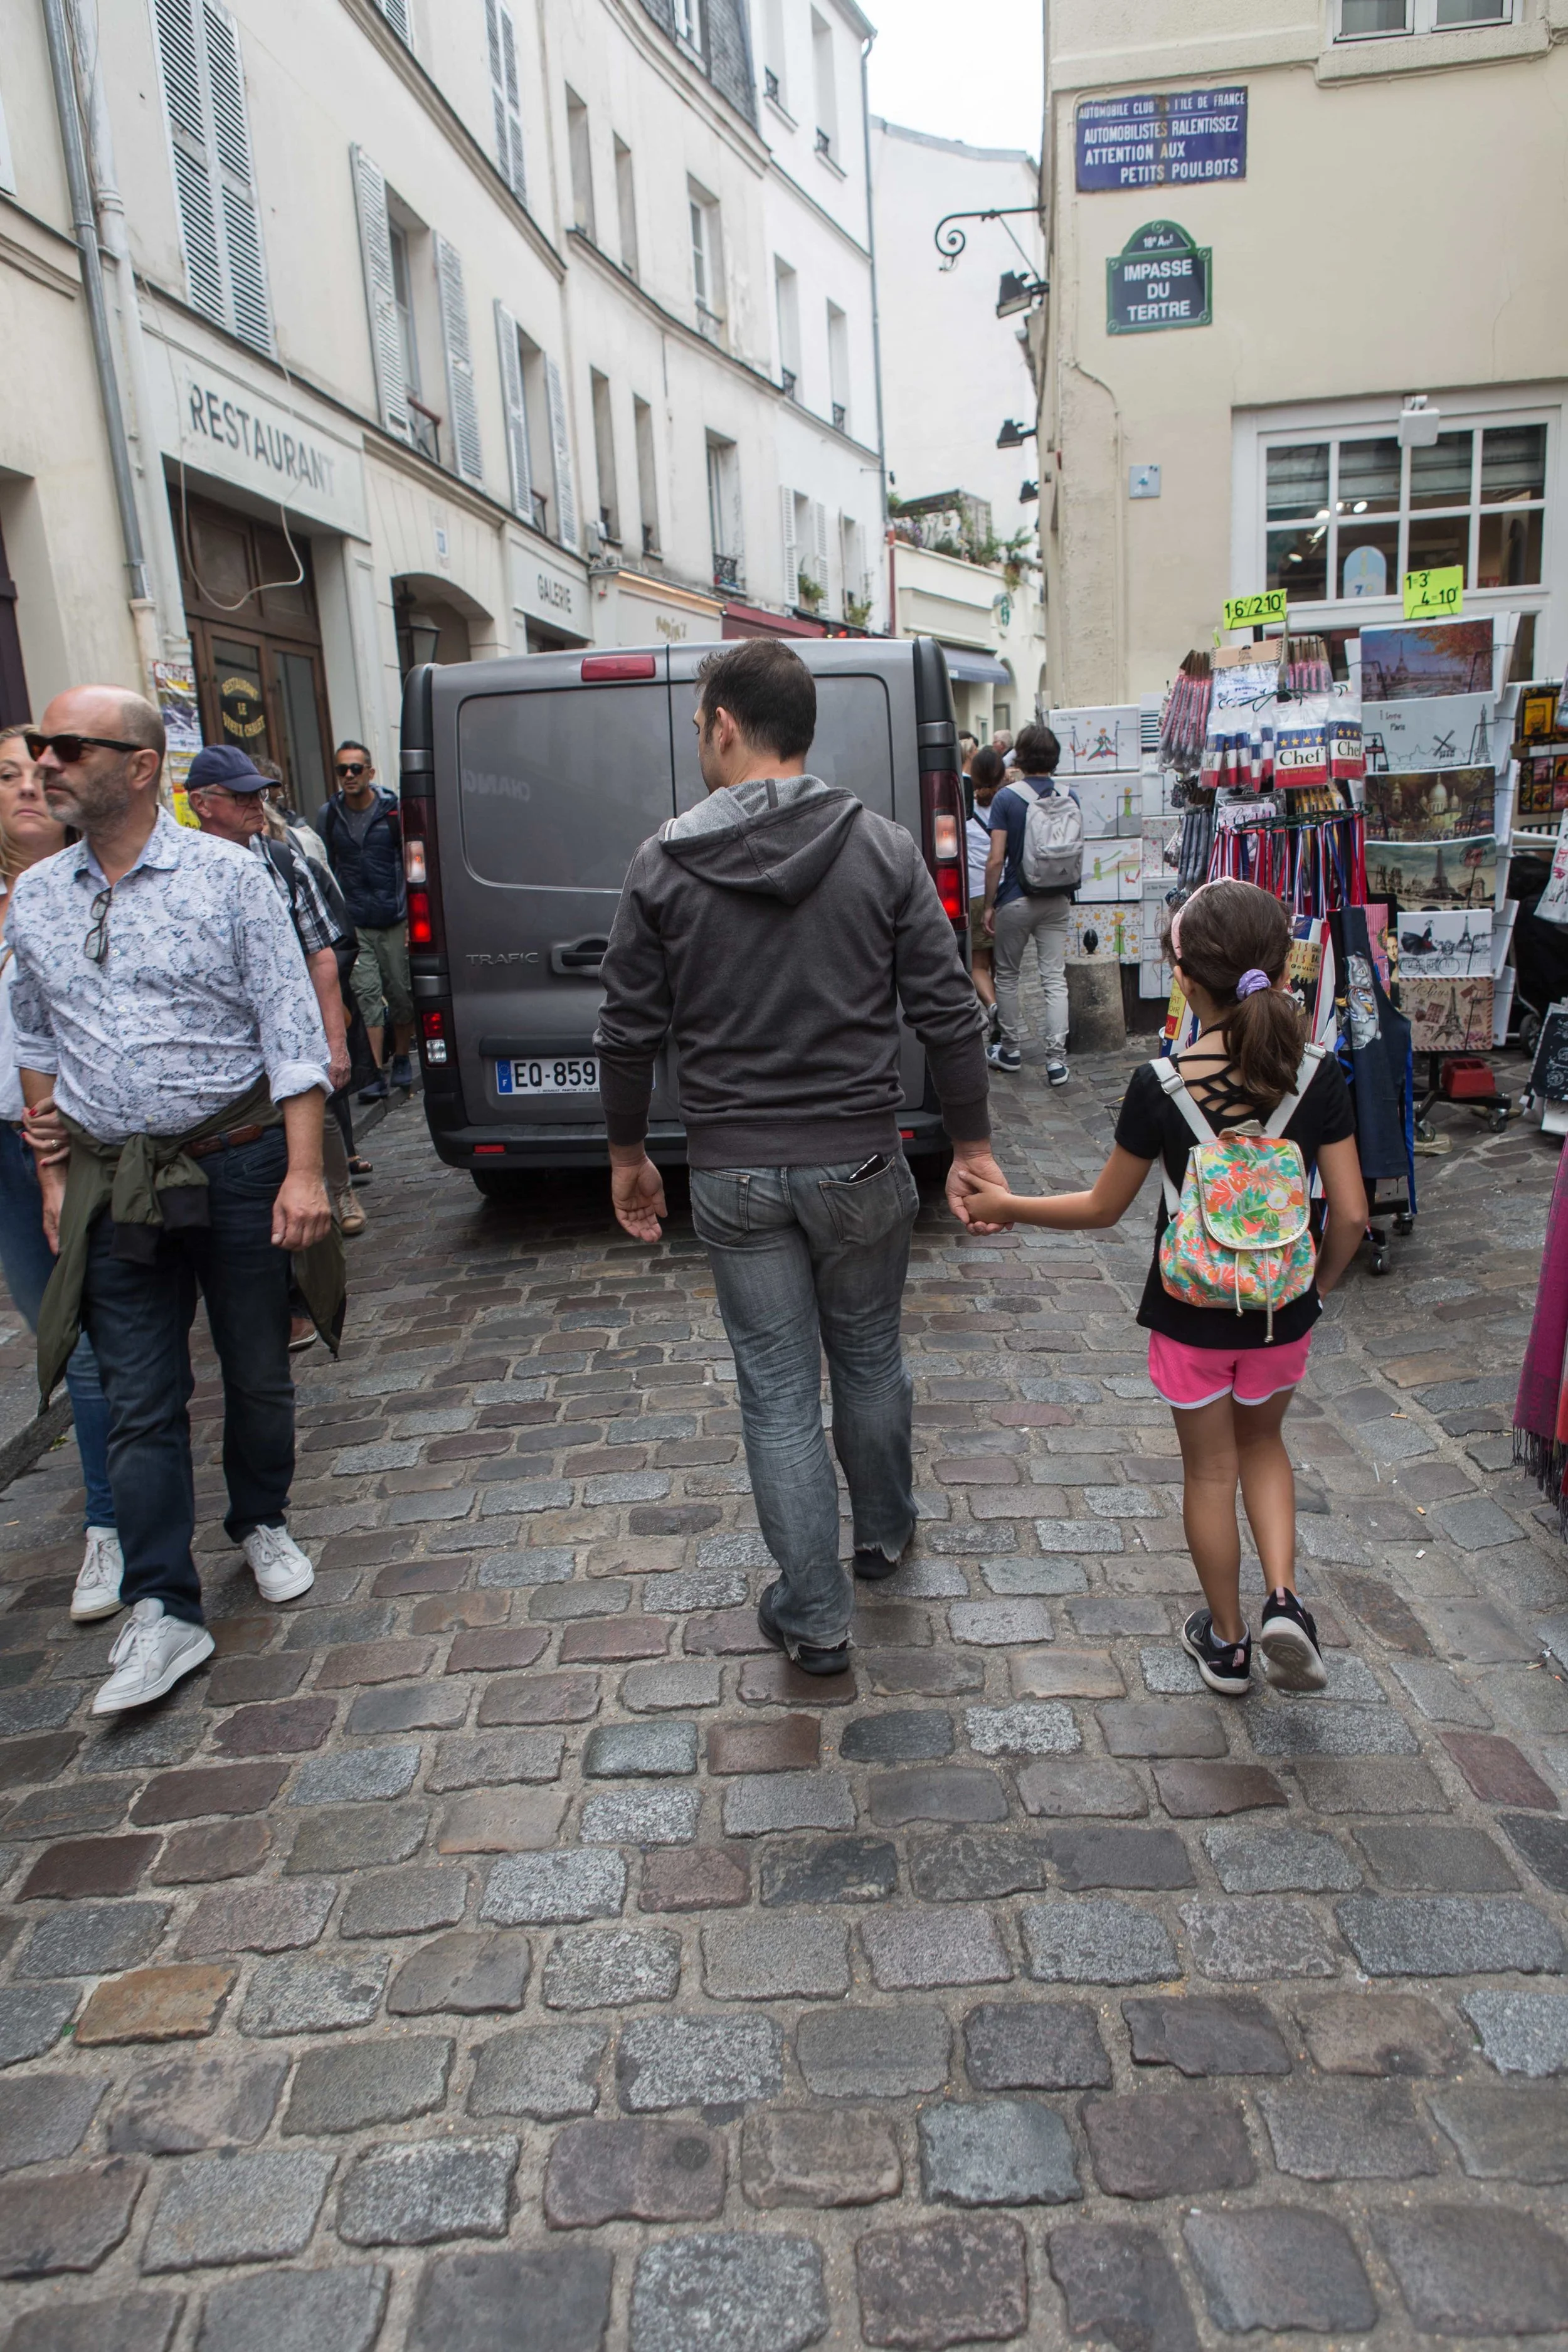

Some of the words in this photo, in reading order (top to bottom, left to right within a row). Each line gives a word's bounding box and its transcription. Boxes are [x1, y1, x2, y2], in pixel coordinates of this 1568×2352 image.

[1079, 103, 1128, 120] AUTOMOBILE
[1133, 101, 1154, 115] CLUB
[1197, 95, 1208, 109] DE
[1214, 92, 1245, 107] FRANCE
[1084, 122, 1168, 145] AUTOMOBILISTES
[1172, 115, 1239, 137] RALENTISSEZ
[1085, 144, 1153, 166] ATTENTION
[1160, 141, 1185, 159] AUX
[1120, 164, 1164, 184] PETITS
[1172, 158, 1239, 179] POULBOTS
[1124, 258, 1192, 282] IMPASSE
[1147, 281, 1170, 300] DU
[1126, 300, 1190, 321] TERTRE
[189, 383, 334, 498] RESTAURANT
[538, 573, 571, 614] GALERIE
[237, 702, 247, 715] LE
[1279, 748, 1323, 766] Chef
[466, 952, 539, 966] TRAFIC
